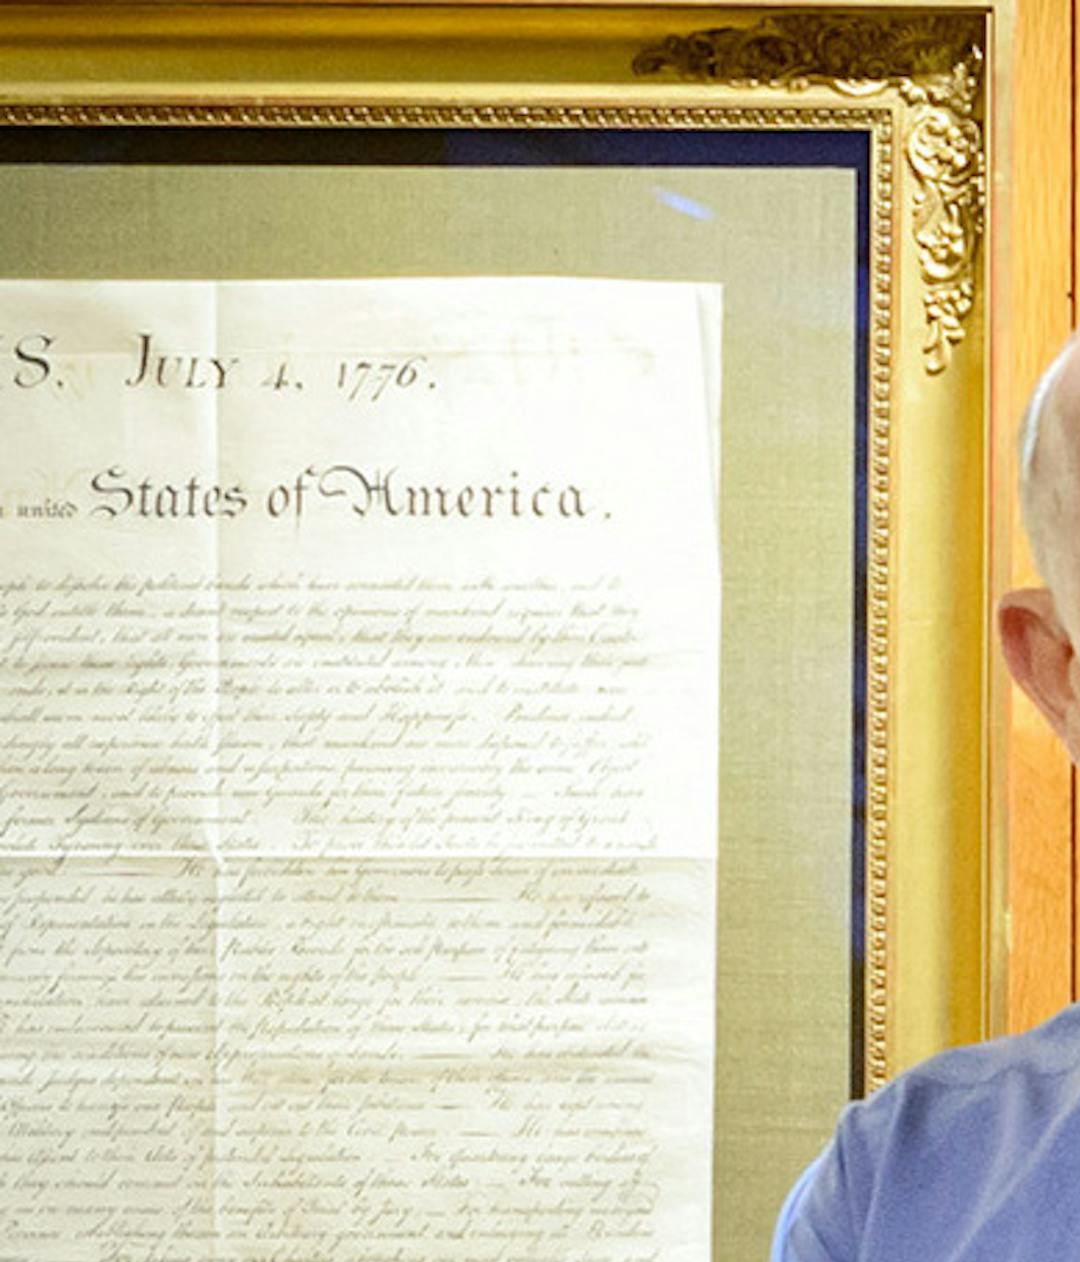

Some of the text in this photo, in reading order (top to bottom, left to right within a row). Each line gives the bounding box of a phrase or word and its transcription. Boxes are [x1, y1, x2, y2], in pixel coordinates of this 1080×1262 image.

[15, 498, 78, 518] united
[90, 465, 249, 519] States
[266, 466, 316, 528] of
